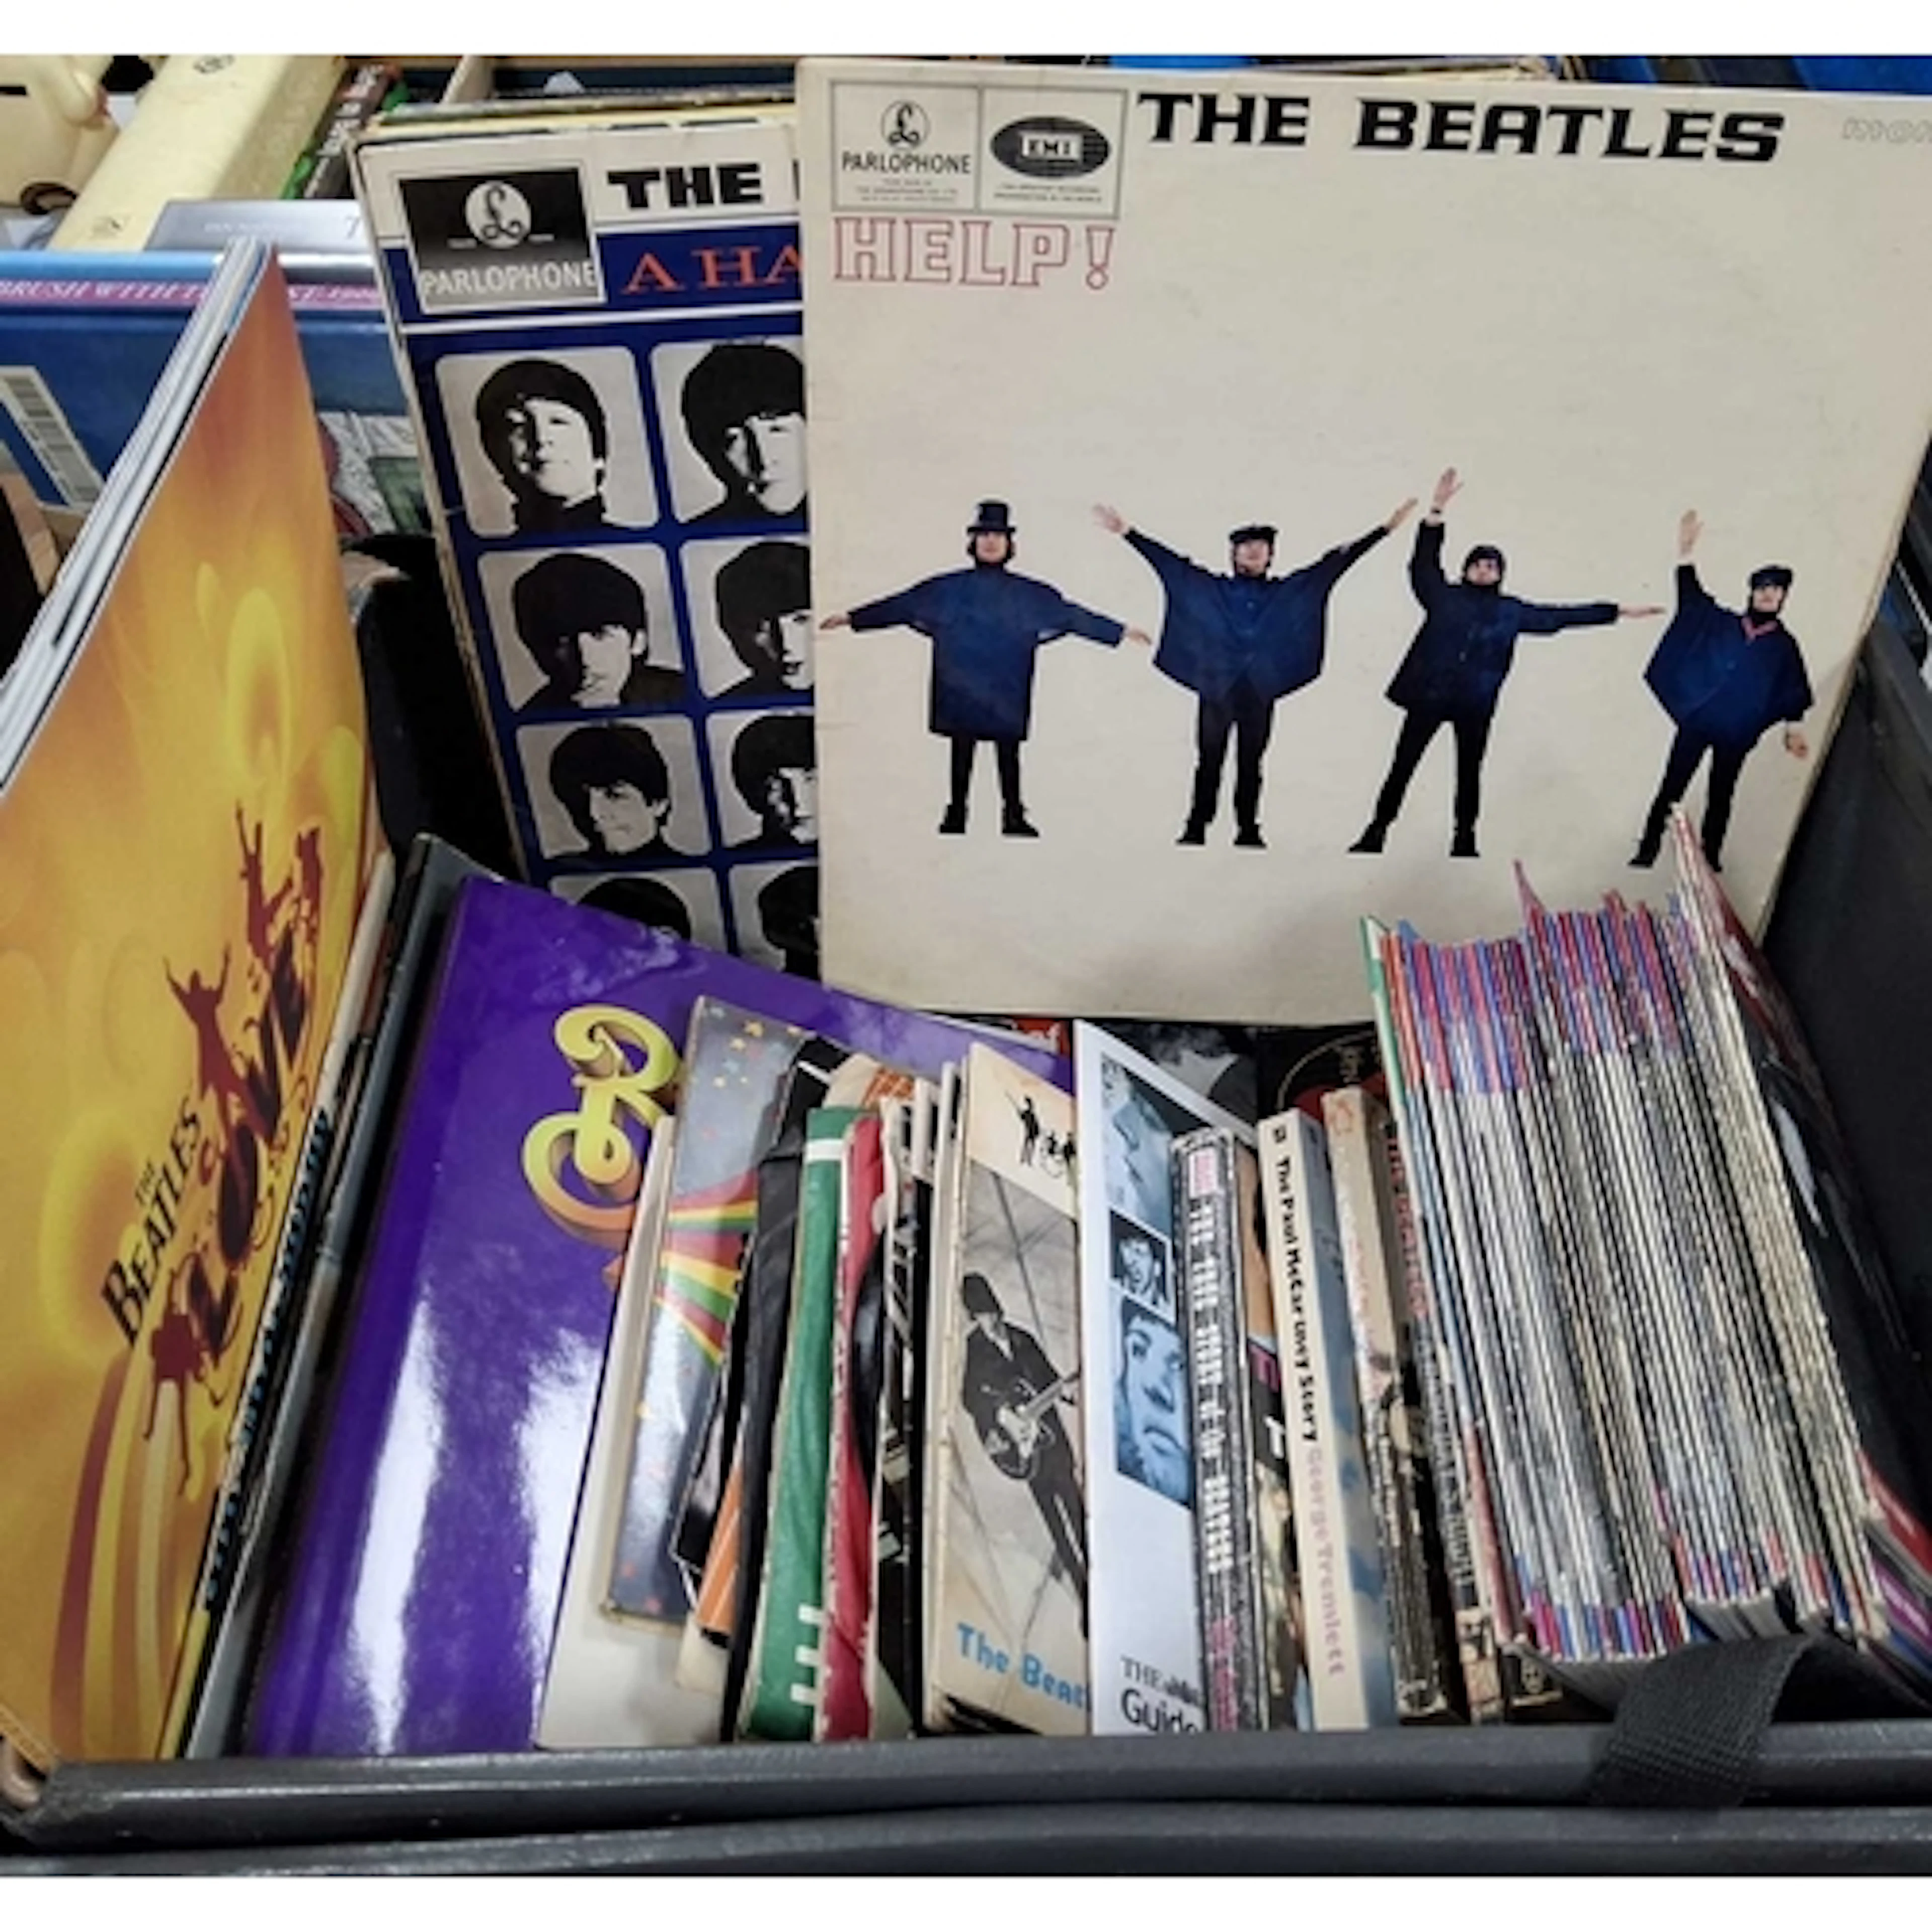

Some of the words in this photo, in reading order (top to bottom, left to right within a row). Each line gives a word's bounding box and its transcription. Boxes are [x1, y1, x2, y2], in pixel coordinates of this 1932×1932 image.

[1137, 92, 1310, 145] THE
[1353, 97, 1785, 161] BEATLES
[607, 163, 764, 208] THE
[842, 151, 971, 174] PARLOPHONE
[421, 260, 598, 296] PARLOPHONE
[620, 252, 685, 296] A
[833, 216, 1117, 290] HELP!
[1275, 1155, 1291, 1193] The
[100, 1095, 202, 1348] BEATLES
[1280, 1196, 1299, 1245] Paul
[1286, 1249, 1310, 1369] McCartney
[1299, 1376, 1318, 1441] Story
[1307, 1448, 1329, 1541] George
[1317, 1543, 1346, 1676] Tremlett
[957, 1622, 1010, 1674] The
[1120, 1654, 1164, 1689] THE
